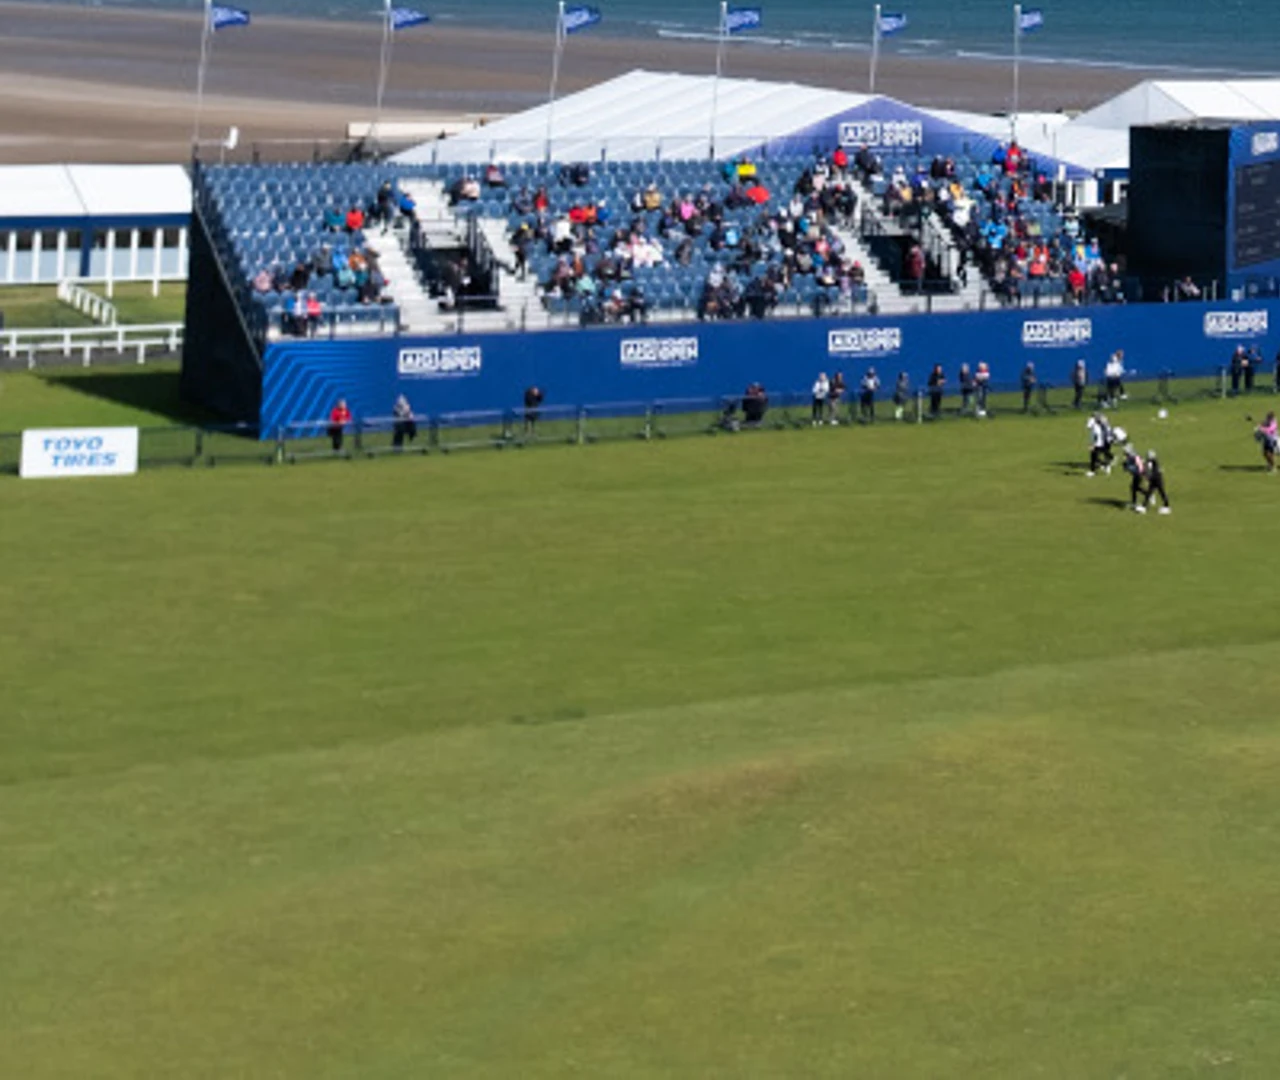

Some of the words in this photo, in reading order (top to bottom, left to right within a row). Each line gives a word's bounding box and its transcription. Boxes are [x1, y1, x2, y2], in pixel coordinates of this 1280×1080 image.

[842, 124, 879, 144] AIG
[43, 436, 104, 451] TOYO
[52, 453, 118, 467] TIRES
